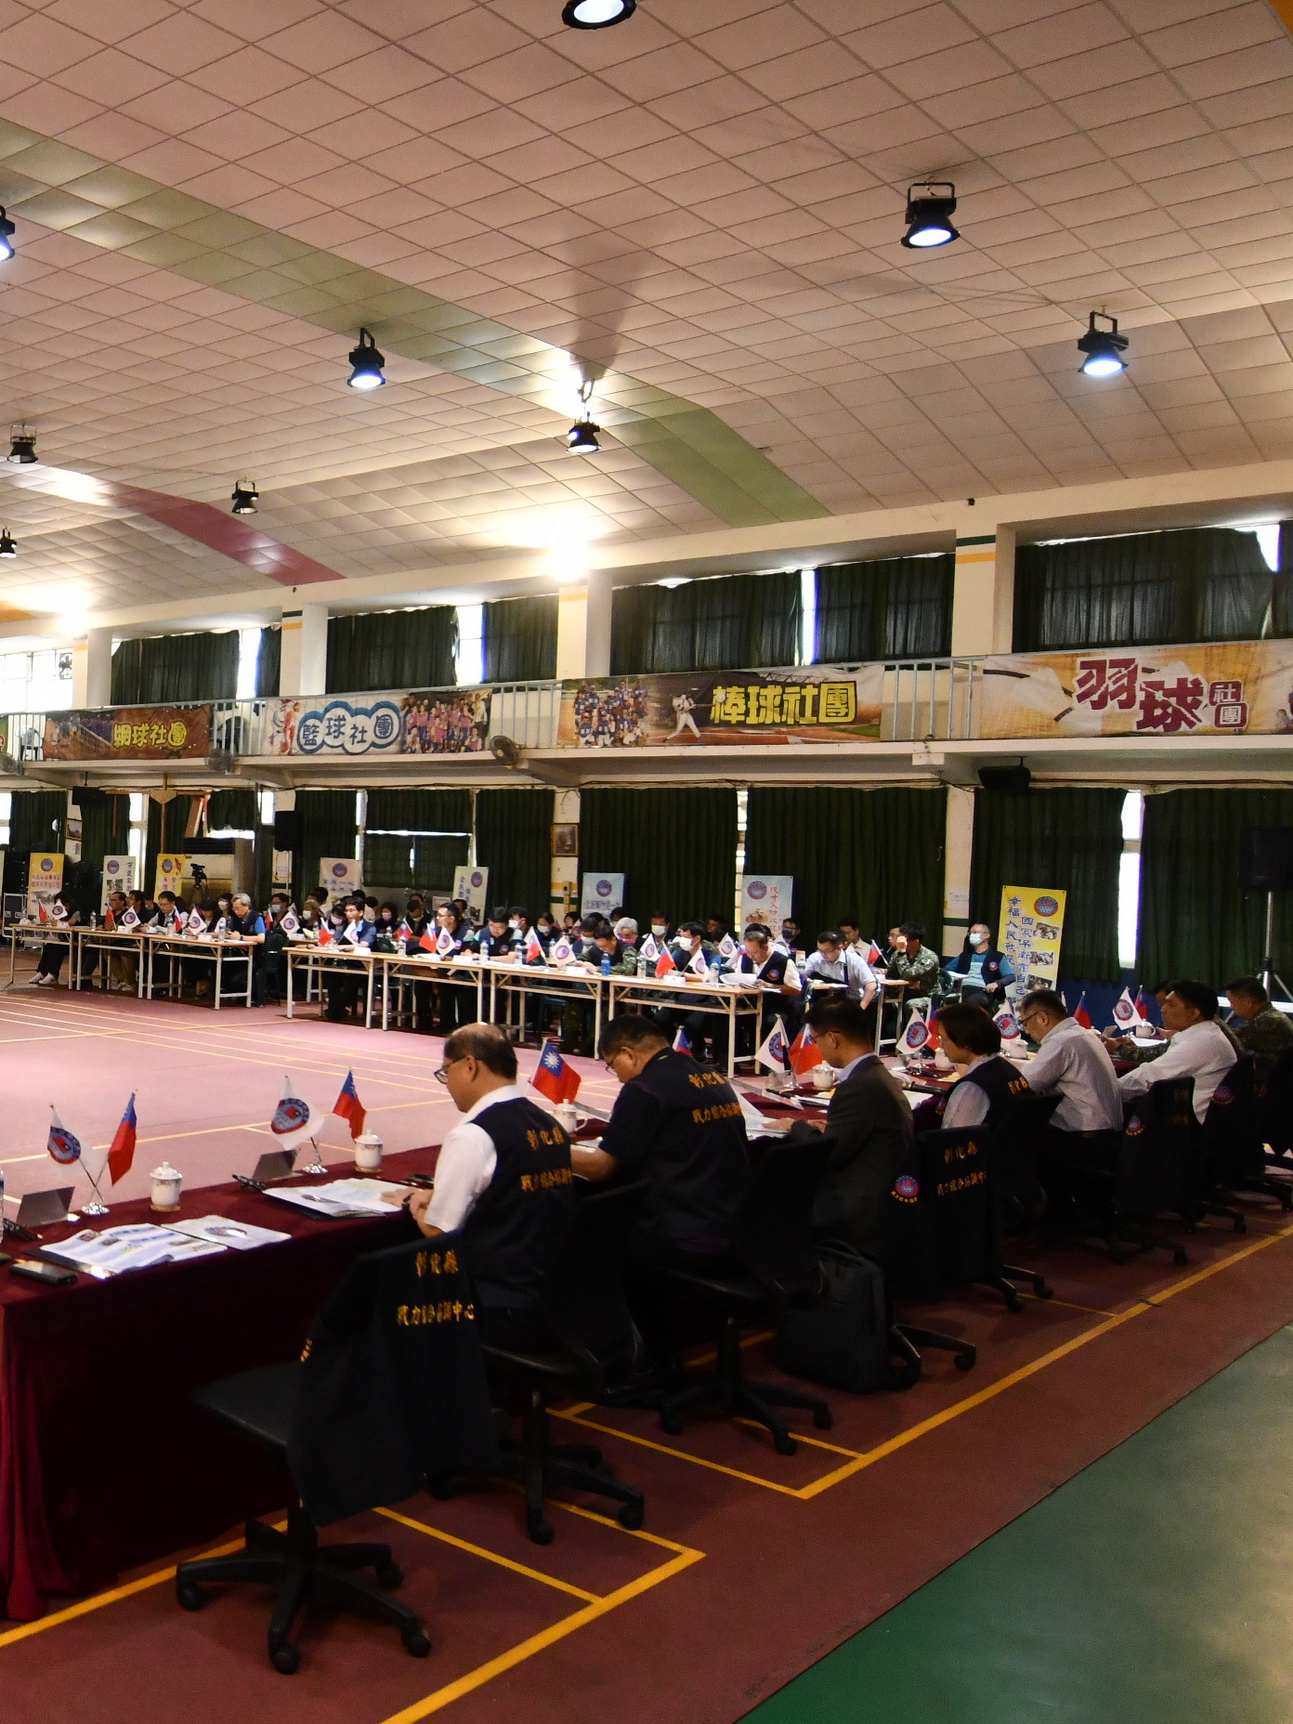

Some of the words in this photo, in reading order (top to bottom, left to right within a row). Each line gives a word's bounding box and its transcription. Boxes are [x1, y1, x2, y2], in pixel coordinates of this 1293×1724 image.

[710, 682, 856, 725] 棒球社團
[113, 721, 187, 748] 網球社團
[302, 713, 395, 747] 籃球社團
